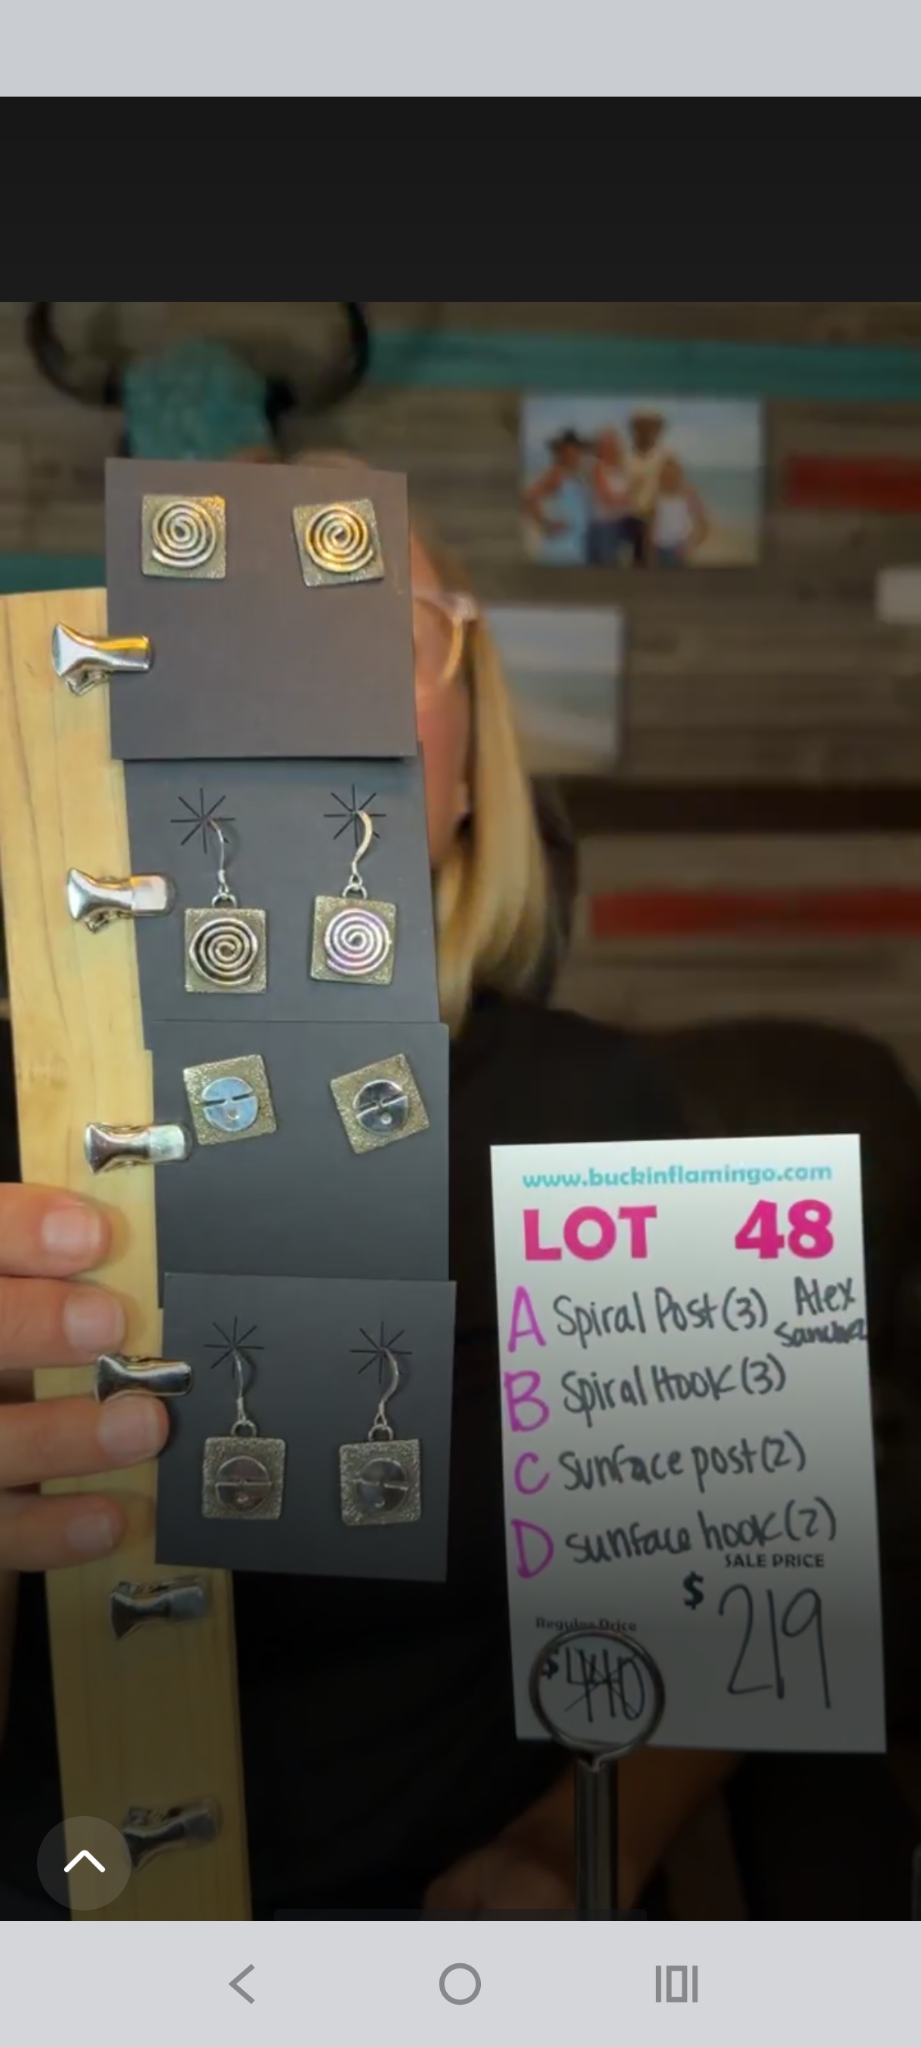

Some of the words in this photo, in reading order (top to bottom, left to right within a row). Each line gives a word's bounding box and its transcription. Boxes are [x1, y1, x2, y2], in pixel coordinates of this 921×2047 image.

[522, 1164, 833, 1189] www.buckinflamingo.com
[523, 1205, 658, 1261] LOT
[734, 1199, 834, 1259] 48
[507, 1285, 547, 1353] A
[553, 1289, 646, 1349] Spiral
[794, 1276, 856, 1316] Alex
[503, 1370, 550, 1432] B
[561, 1364, 647, 1428] Spiral
[514, 1452, 550, 1494] C
[510, 1518, 554, 1579] D
[725, 1554, 767, 1568] SALE
[772, 1553, 825, 1568] PRICE
[599, 1618, 637, 1632] Price
[718, 1583, 831, 1709] 219
